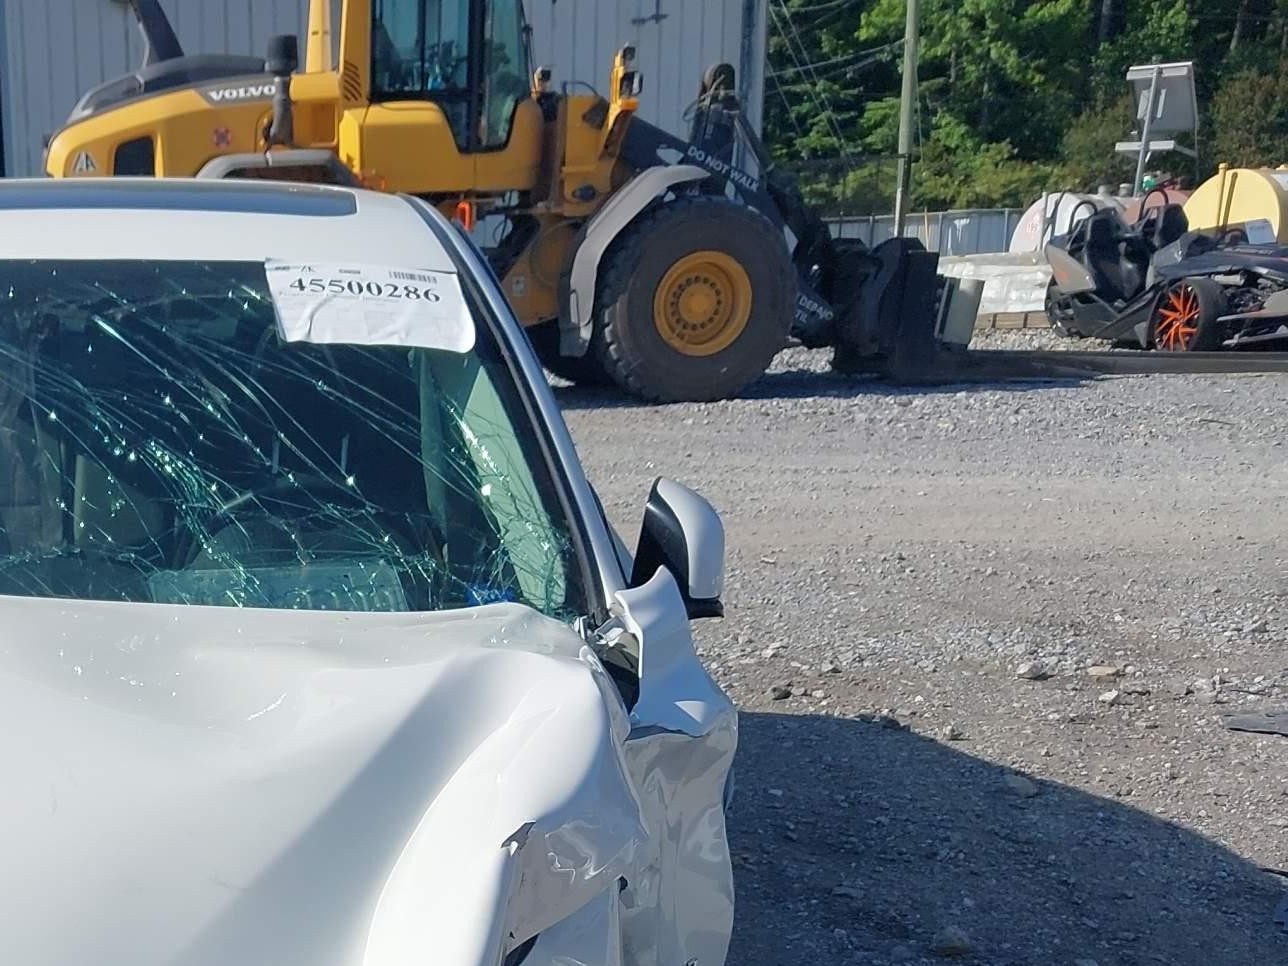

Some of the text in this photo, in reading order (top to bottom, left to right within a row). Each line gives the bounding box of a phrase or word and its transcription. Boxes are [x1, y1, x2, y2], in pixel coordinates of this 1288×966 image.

[209, 84, 277, 101] VOLVO
[687, 145, 760, 192] DO NOT WALK
[289, 277, 441, 303] 45500286
